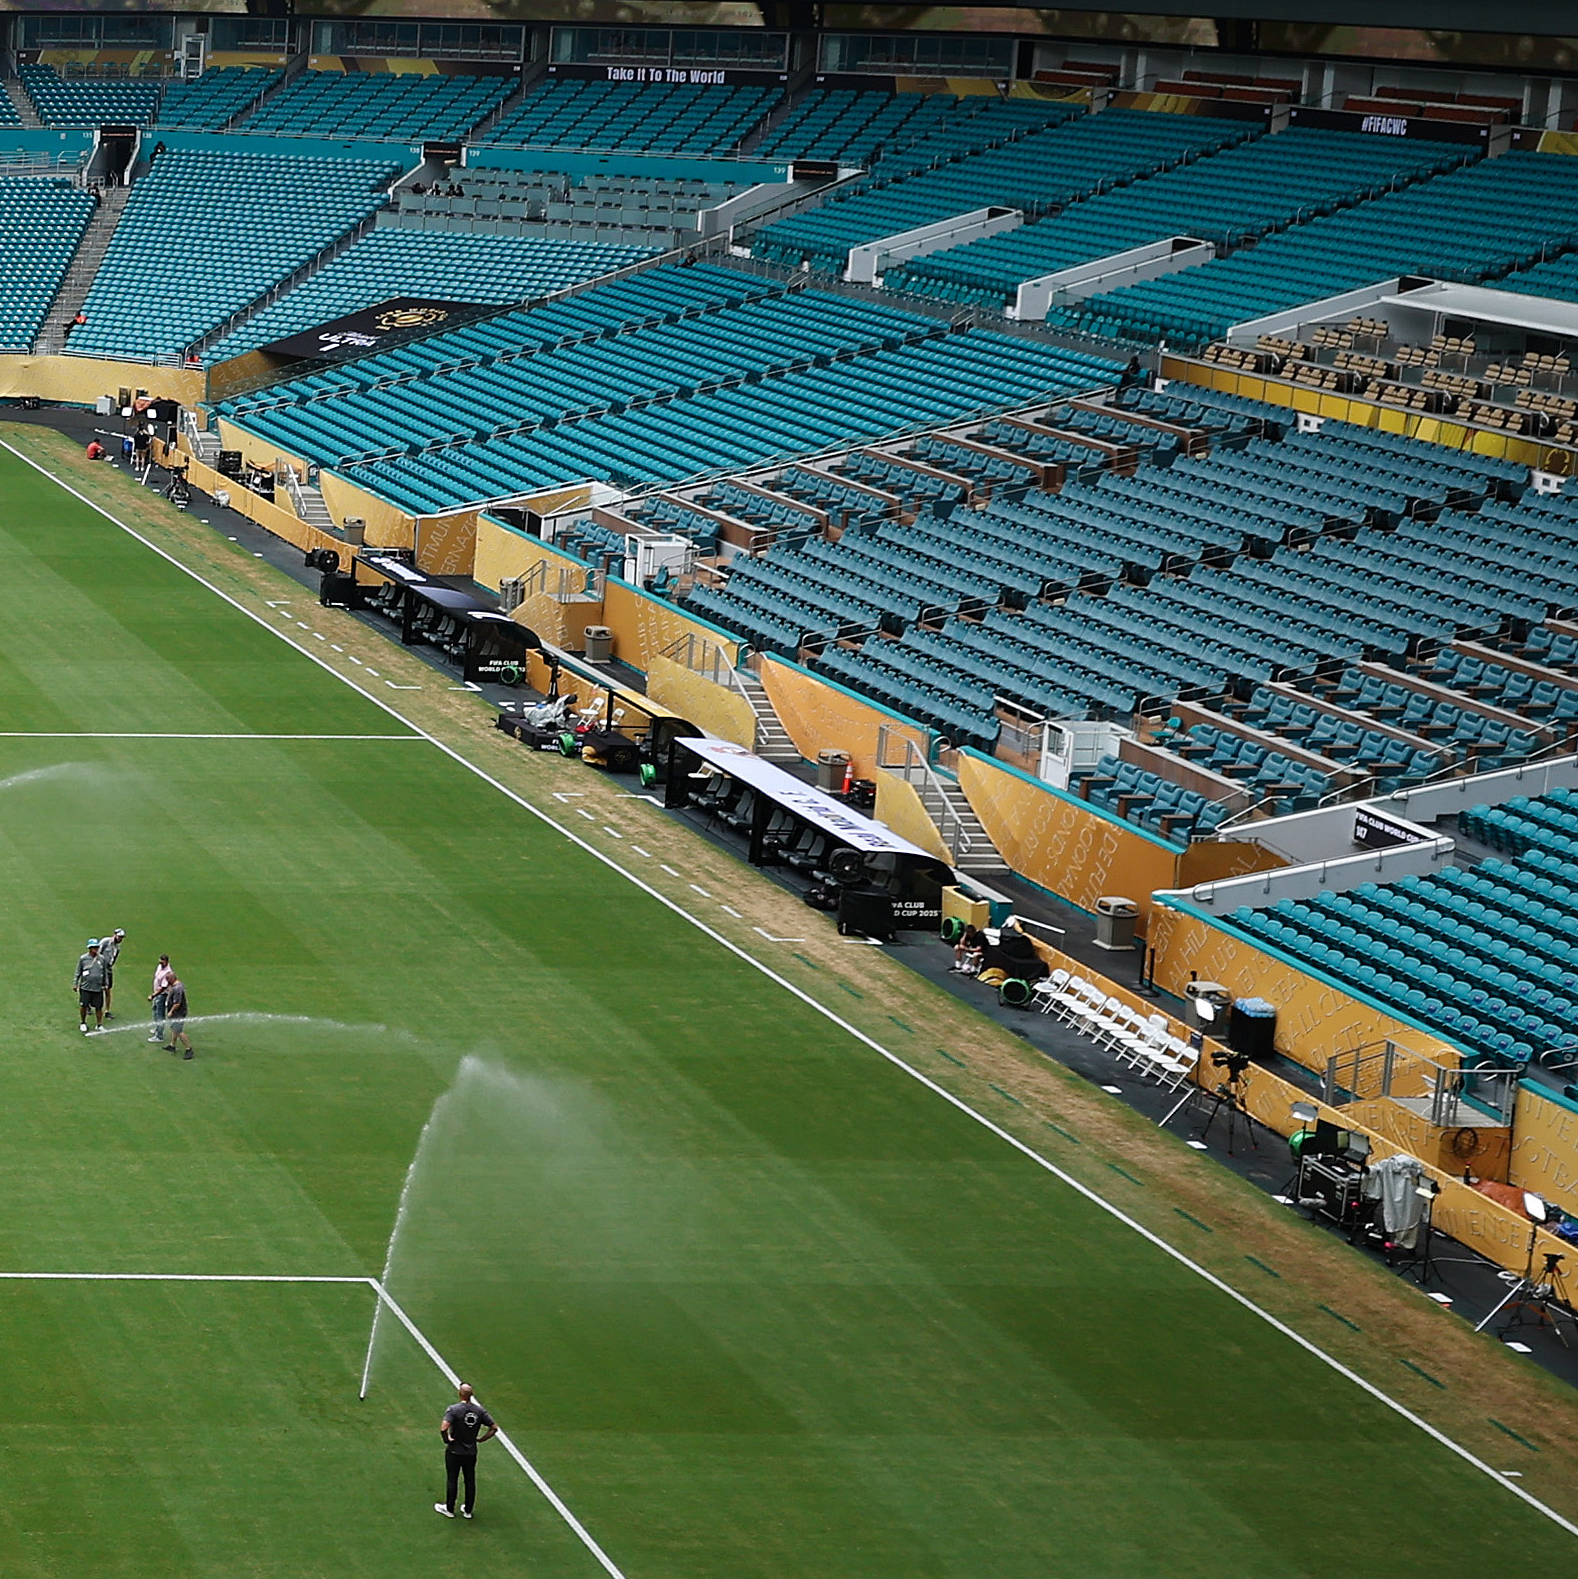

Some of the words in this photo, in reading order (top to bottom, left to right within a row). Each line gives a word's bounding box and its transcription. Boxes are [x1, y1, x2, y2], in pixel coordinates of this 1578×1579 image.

[607, 66, 634, 82] Take
[636, 66, 646, 82] It
[648, 67, 662, 82] To
[665, 68, 686, 83] The
[689, 68, 725, 85] World
[1361, 116, 1407, 136] #FIFACWC
